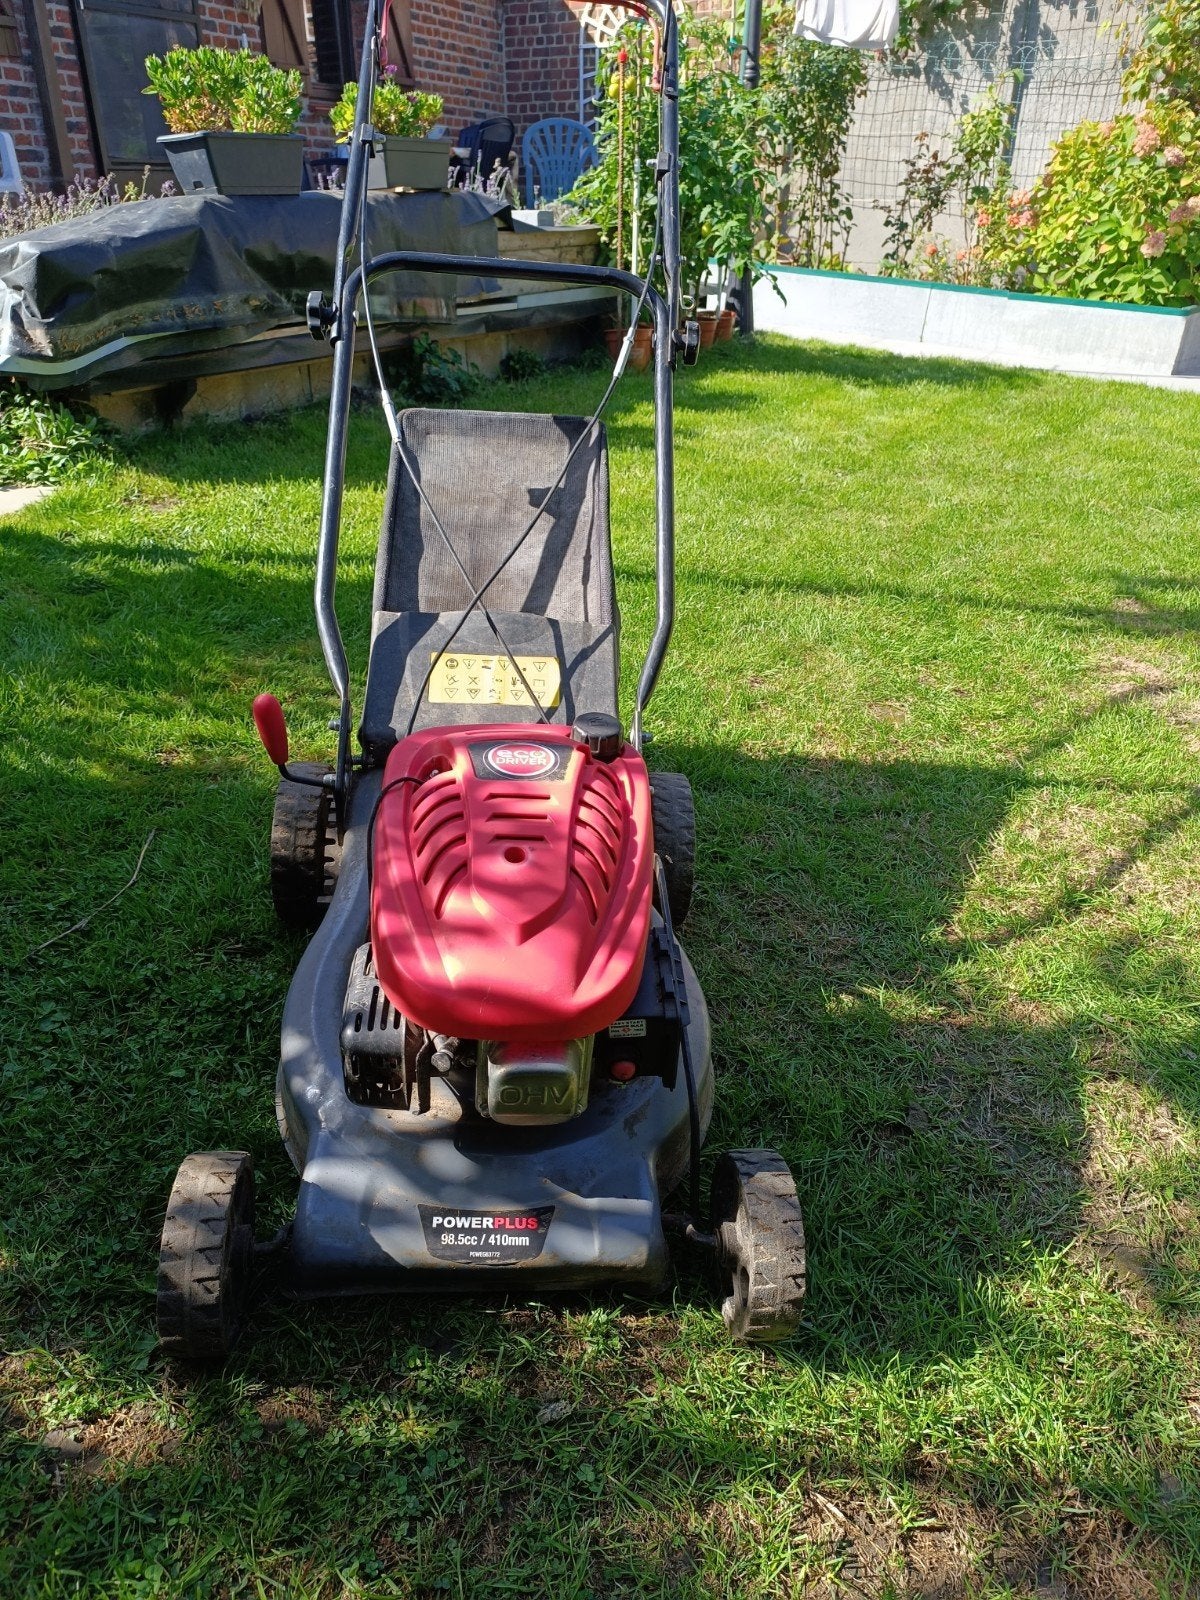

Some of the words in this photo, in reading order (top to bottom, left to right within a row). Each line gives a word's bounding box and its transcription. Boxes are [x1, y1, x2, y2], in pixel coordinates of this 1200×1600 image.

[496, 757, 547, 766] DRIVER
[500, 1085, 574, 1105] OHV
[432, 1216, 538, 1230] POWERPLUS
[441, 1233, 477, 1246] 98.5cc
[479, 1234, 487, 1246] /
[488, 1234, 530, 1246] 410mm
